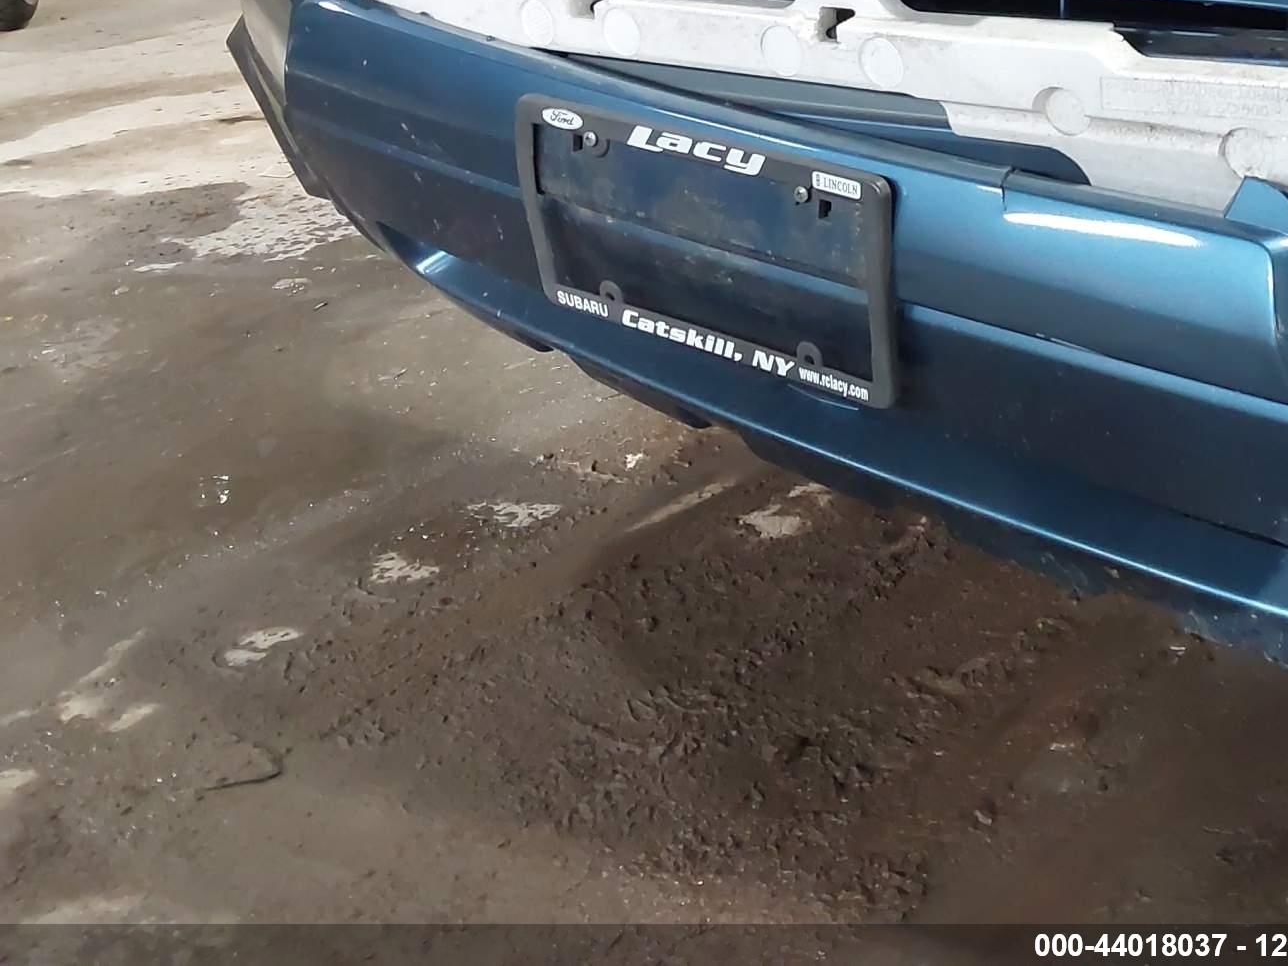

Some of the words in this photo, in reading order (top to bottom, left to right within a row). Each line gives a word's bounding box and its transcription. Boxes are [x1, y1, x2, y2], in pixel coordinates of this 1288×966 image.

[551, 109, 574, 126] Ford
[626, 125, 766, 176] Lacy
[823, 177, 858, 195] LINCOLN
[557, 290, 609, 318] SUBARU
[621, 309, 743, 362] Catskill,
[752, 349, 795, 377] NY
[798, 366, 869, 401] www.rclacy.com
